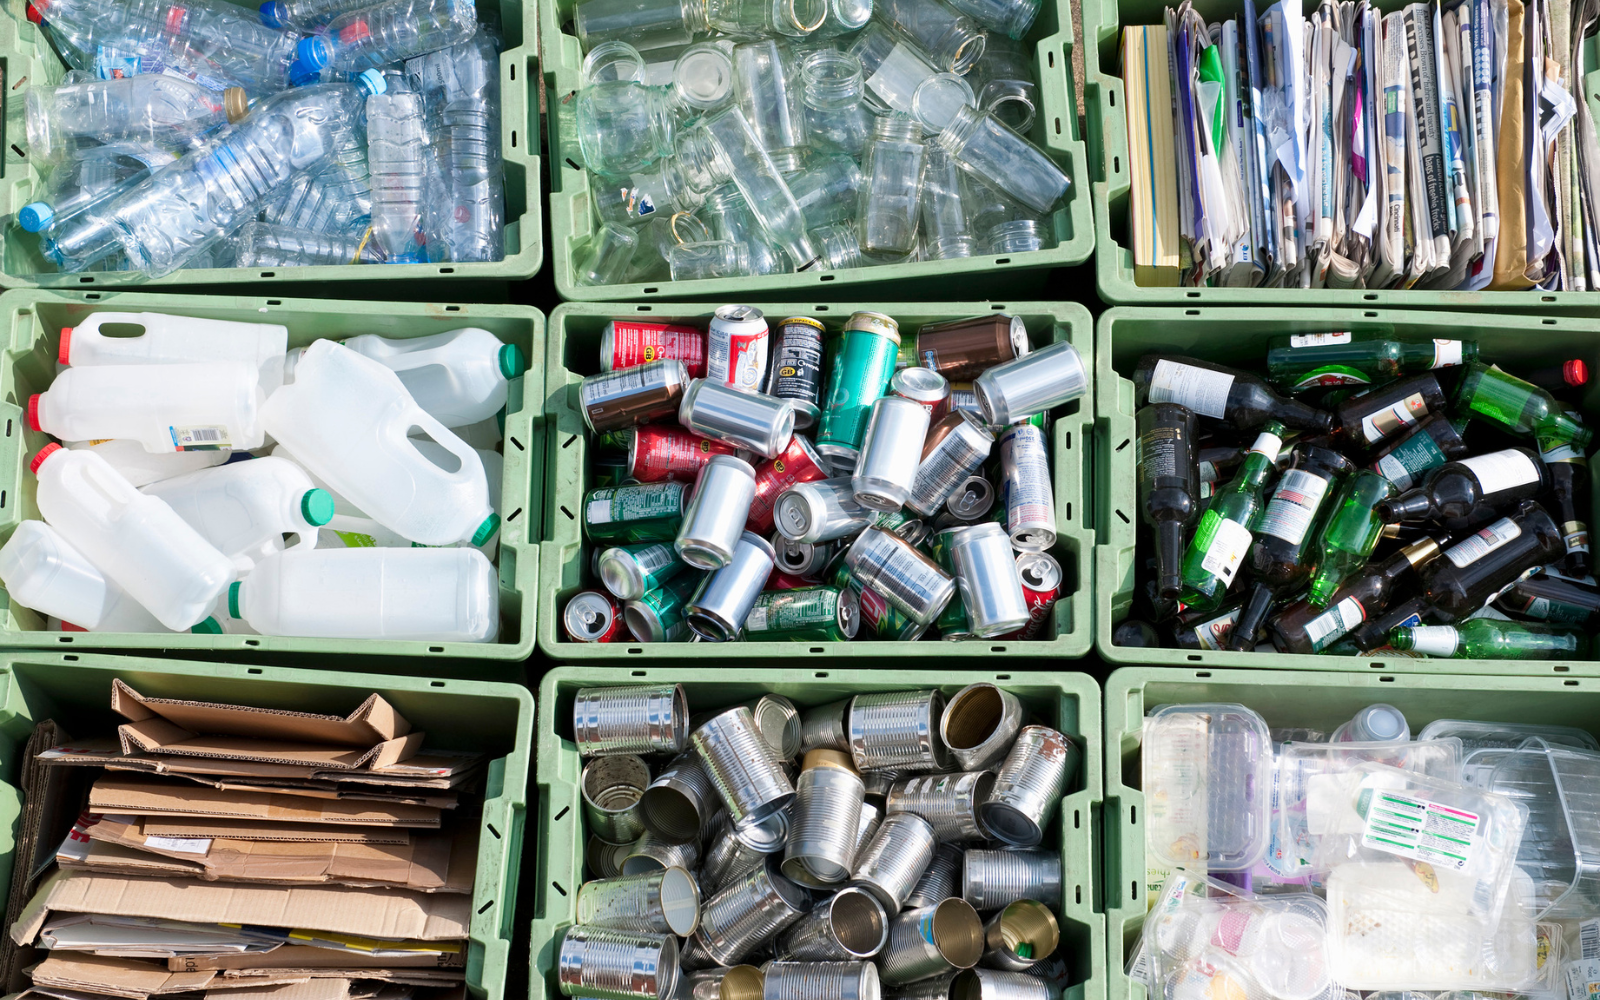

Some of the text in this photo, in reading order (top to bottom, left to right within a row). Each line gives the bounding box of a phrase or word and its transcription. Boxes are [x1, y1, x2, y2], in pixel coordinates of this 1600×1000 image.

[1415, 8, 1424, 25] Blair
[1417, 24, 1425, 50] accuses
[1423, 10, 1433, 51] EXCLUSIVE:
[1419, 50, 1428, 72] Brown
[1422, 71, 1431, 79] of
[1425, 102, 1433, 115] and
[1424, 156, 1441, 231] bags of freebie frocks
[1393, 204, 1401, 233] Cincinnati
[645, 347, 653, 360] GB
[702, 441, 709, 452] GB
[775, 461, 785, 472] GB
